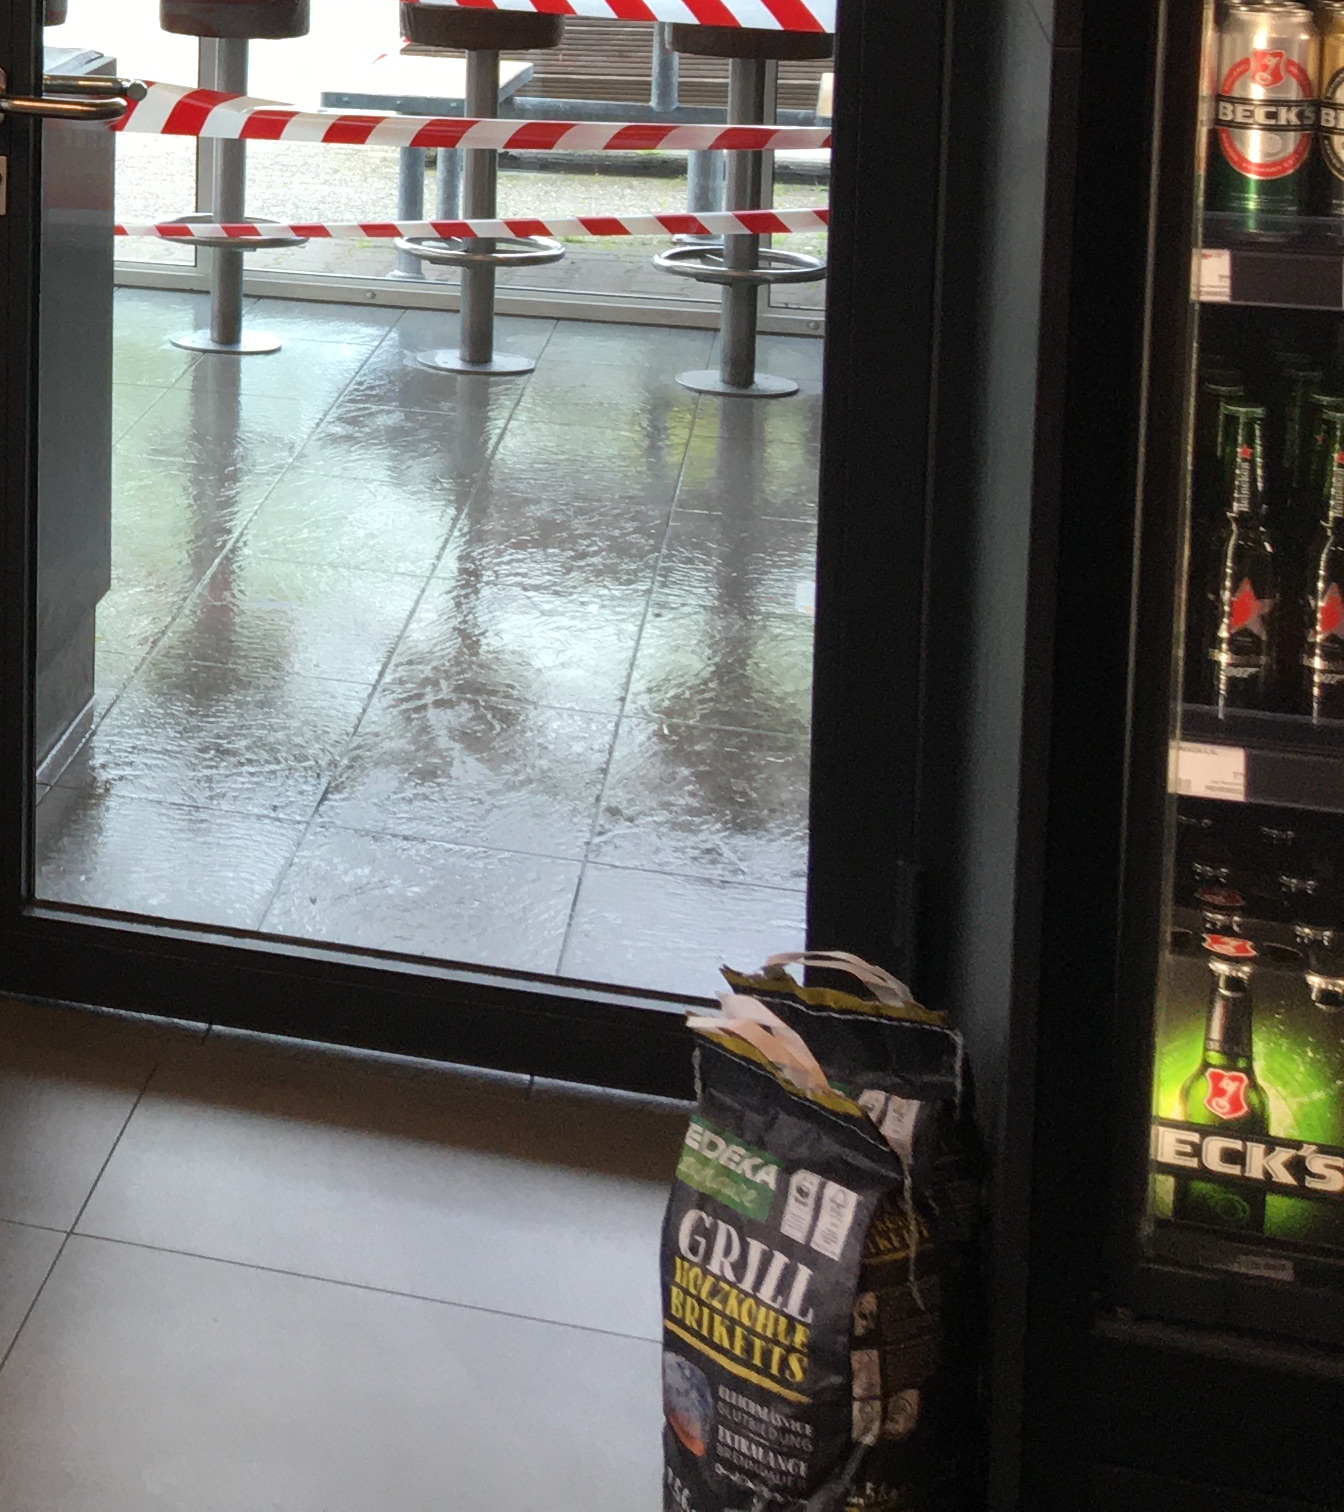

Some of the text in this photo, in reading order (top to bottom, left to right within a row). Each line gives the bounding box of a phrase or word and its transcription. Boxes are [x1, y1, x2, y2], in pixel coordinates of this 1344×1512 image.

[1218, 101, 1315, 125] BECK'S
[685, 1122, 780, 1190] EDEKA
[1155, 1125, 1344, 1193] ECK'S
[674, 1257, 811, 1350] HOLZKOHLE
[679, 1209, 813, 1324] GRILL
[671, 1285, 809, 1383] BRIKETTS
